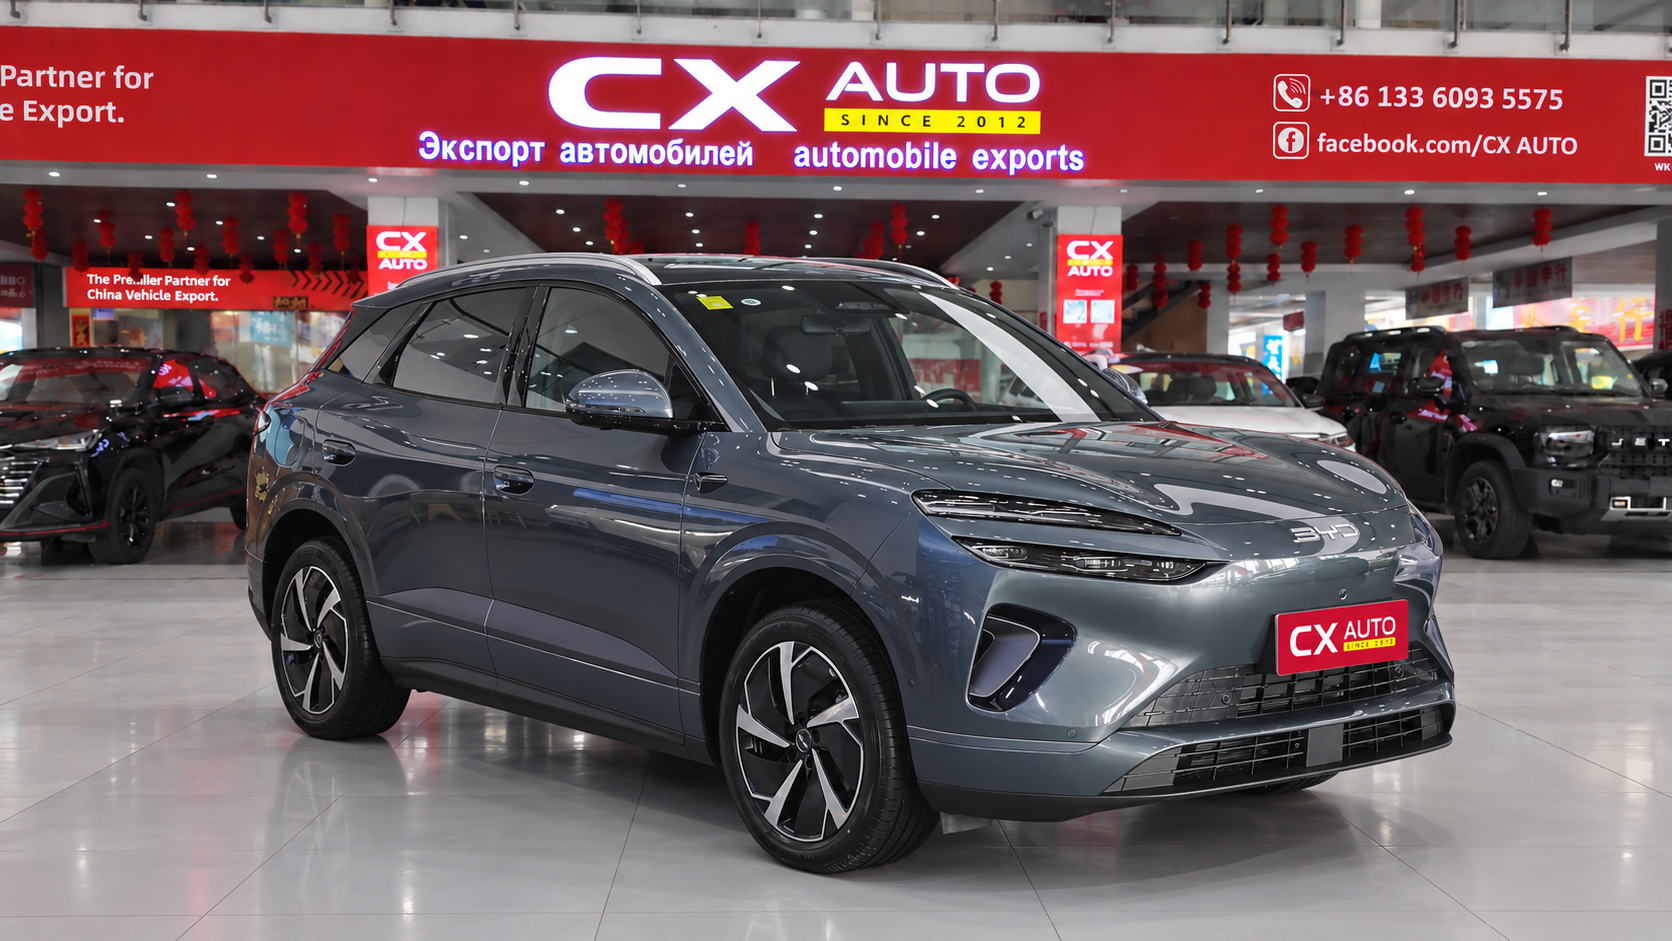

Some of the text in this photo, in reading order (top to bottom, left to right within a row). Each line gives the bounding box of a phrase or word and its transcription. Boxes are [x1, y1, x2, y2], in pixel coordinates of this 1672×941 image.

[1, 65, 154, 89] Partner for
[549, 57, 1040, 132] CX AUTO
[1321, 86, 1562, 110] +86 133 6093 5575
[24, 100, 124, 128] Export.
[842, 114, 1025, 128] SINCE 2012
[418, 131, 752, 168] Экспорт автомобилей
[1317, 133, 1577, 157] facebook.com/CX AUTO
[794, 141, 1084, 175] automobile exports
[1655, 162, 1672, 171] WK
[375, 231, 427, 252] CX
[1066, 240, 1114, 259] CX
[378, 258, 428, 270] AUTO
[1067, 266, 1114, 277] AUTO
[87, 274, 110, 284] The
[165, 276, 210, 286] Partner
[212, 275, 231, 286] for
[87, 289, 218, 303] China Vehicle Export.
[1290, 524, 1360, 543] BYD
[1290, 617, 1395, 656] CX AUTO
